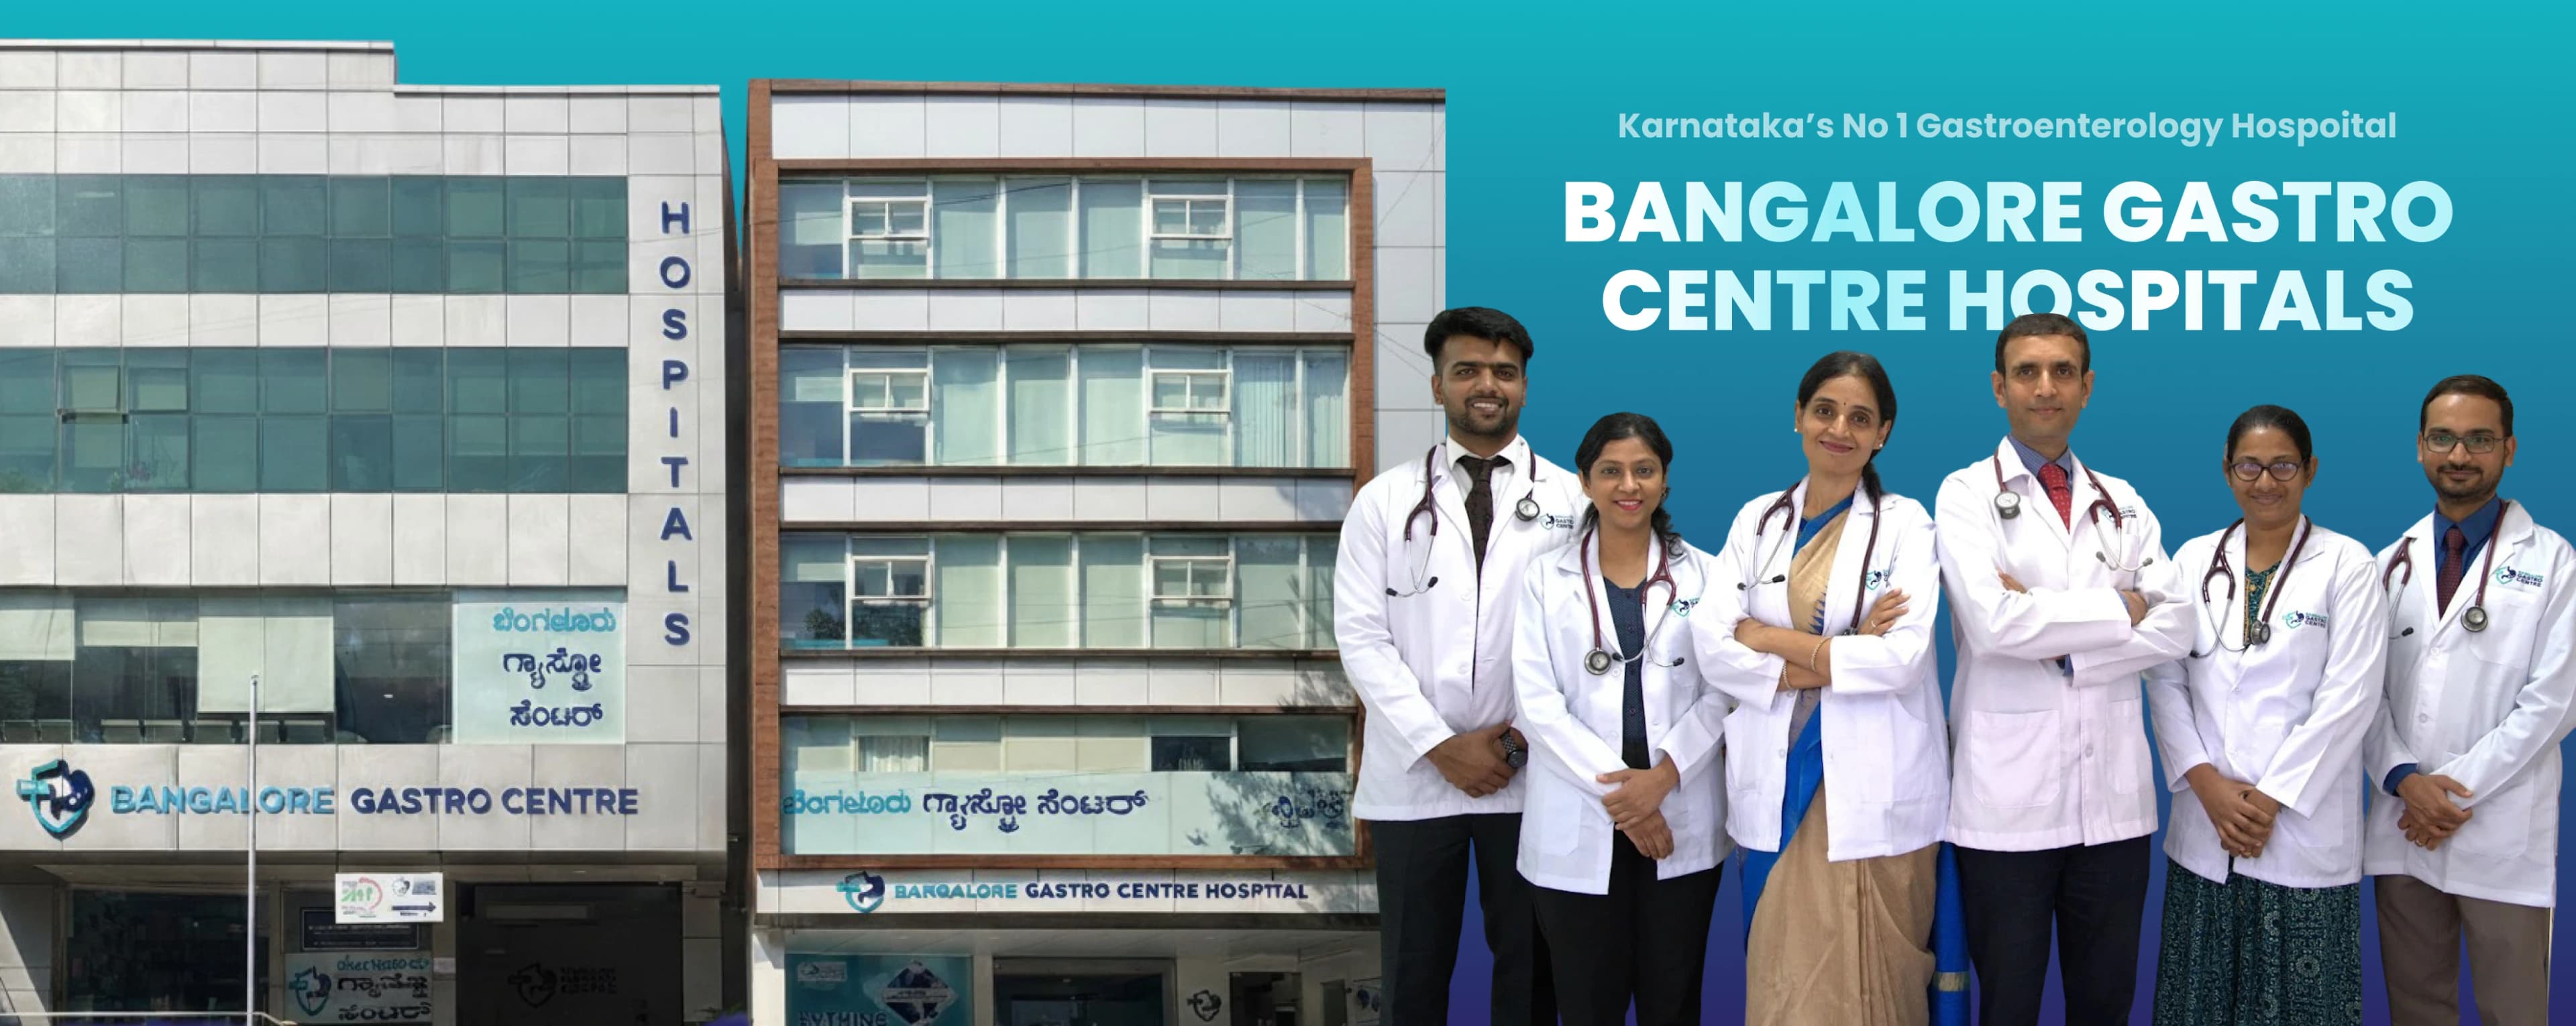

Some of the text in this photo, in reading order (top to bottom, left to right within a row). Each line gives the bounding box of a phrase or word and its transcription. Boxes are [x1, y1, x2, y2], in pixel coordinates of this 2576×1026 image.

[660, 202, 692, 646] HOSPITALS
[111, 785, 639, 816] BANGALORE GASTRO CENTRE
[1025, 883, 1110, 899] GASTRO
[1117, 882, 1199, 899] CENTRE
